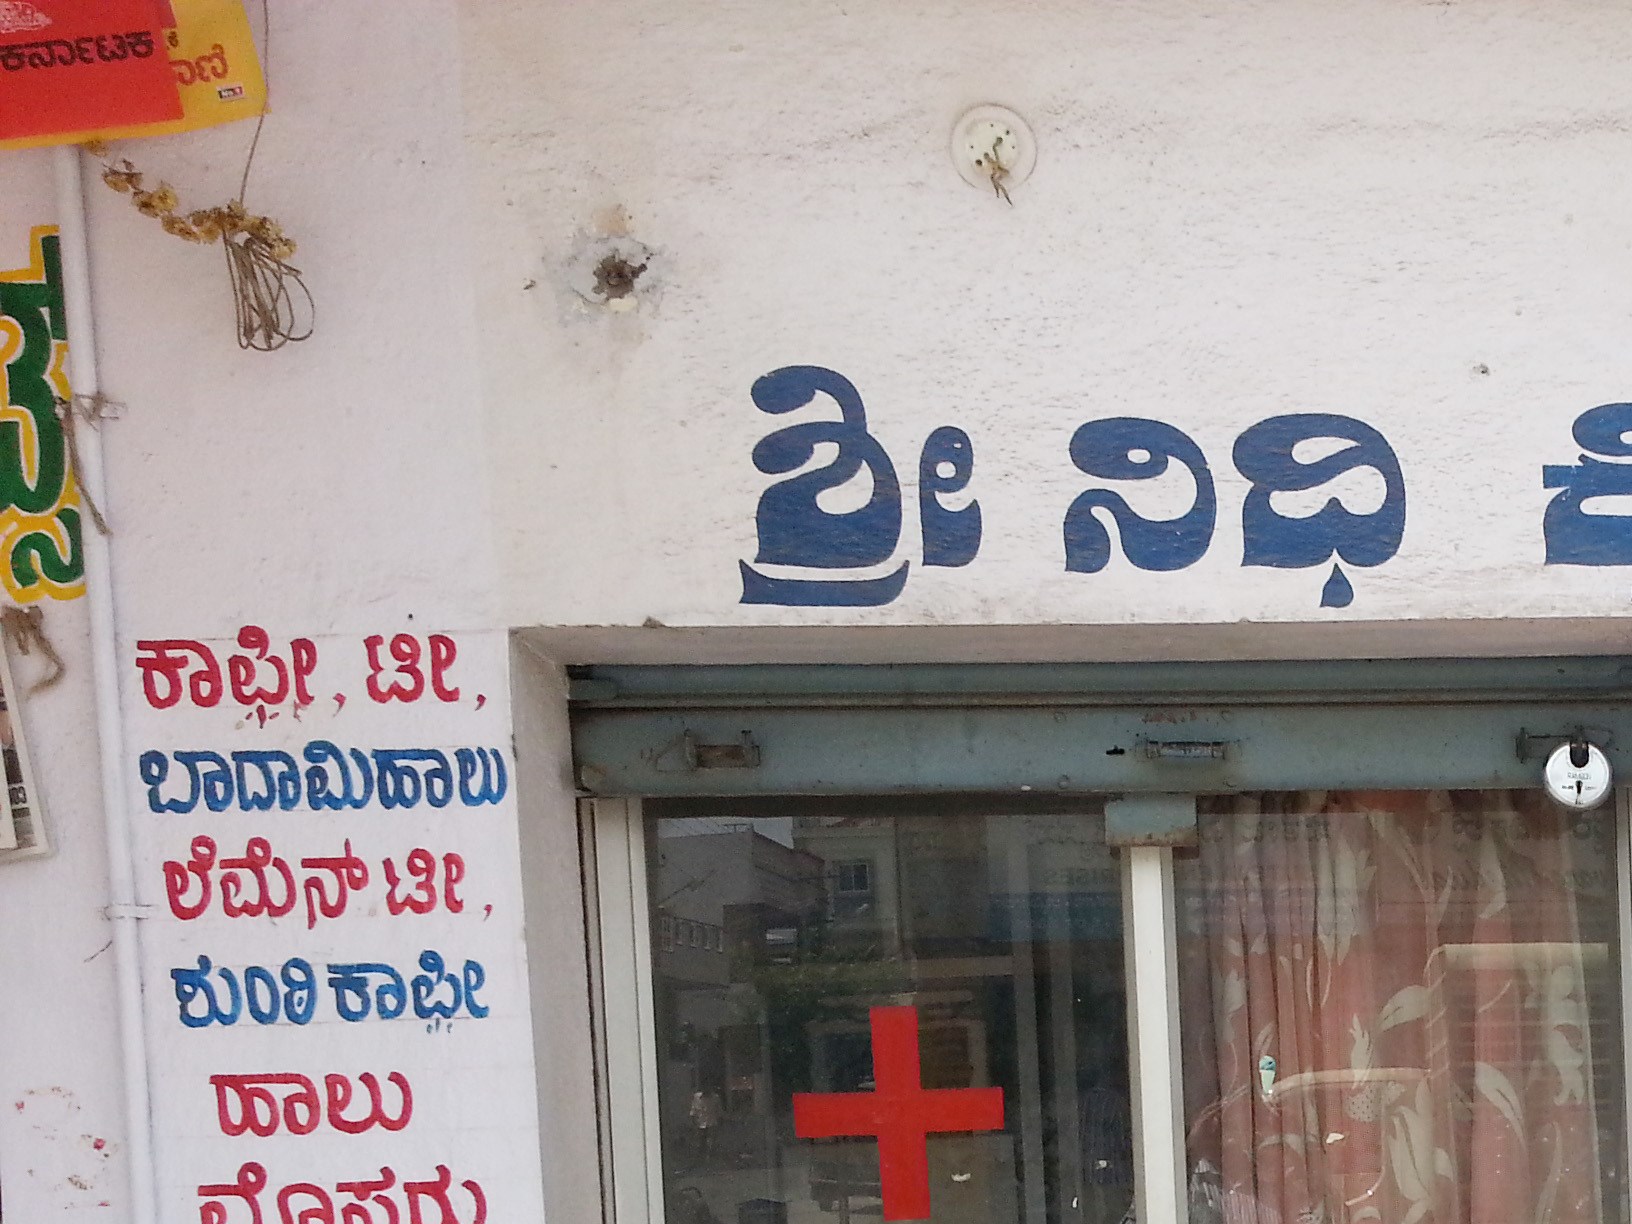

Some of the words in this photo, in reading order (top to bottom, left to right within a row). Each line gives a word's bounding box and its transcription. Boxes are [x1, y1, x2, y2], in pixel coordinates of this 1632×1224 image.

[738, 365, 983, 608] ಶ್ರೀ
[1062, 412, 1407, 609] ನಿಧಿ
[209, 1071, 413, 1138] ಹಾಲು
